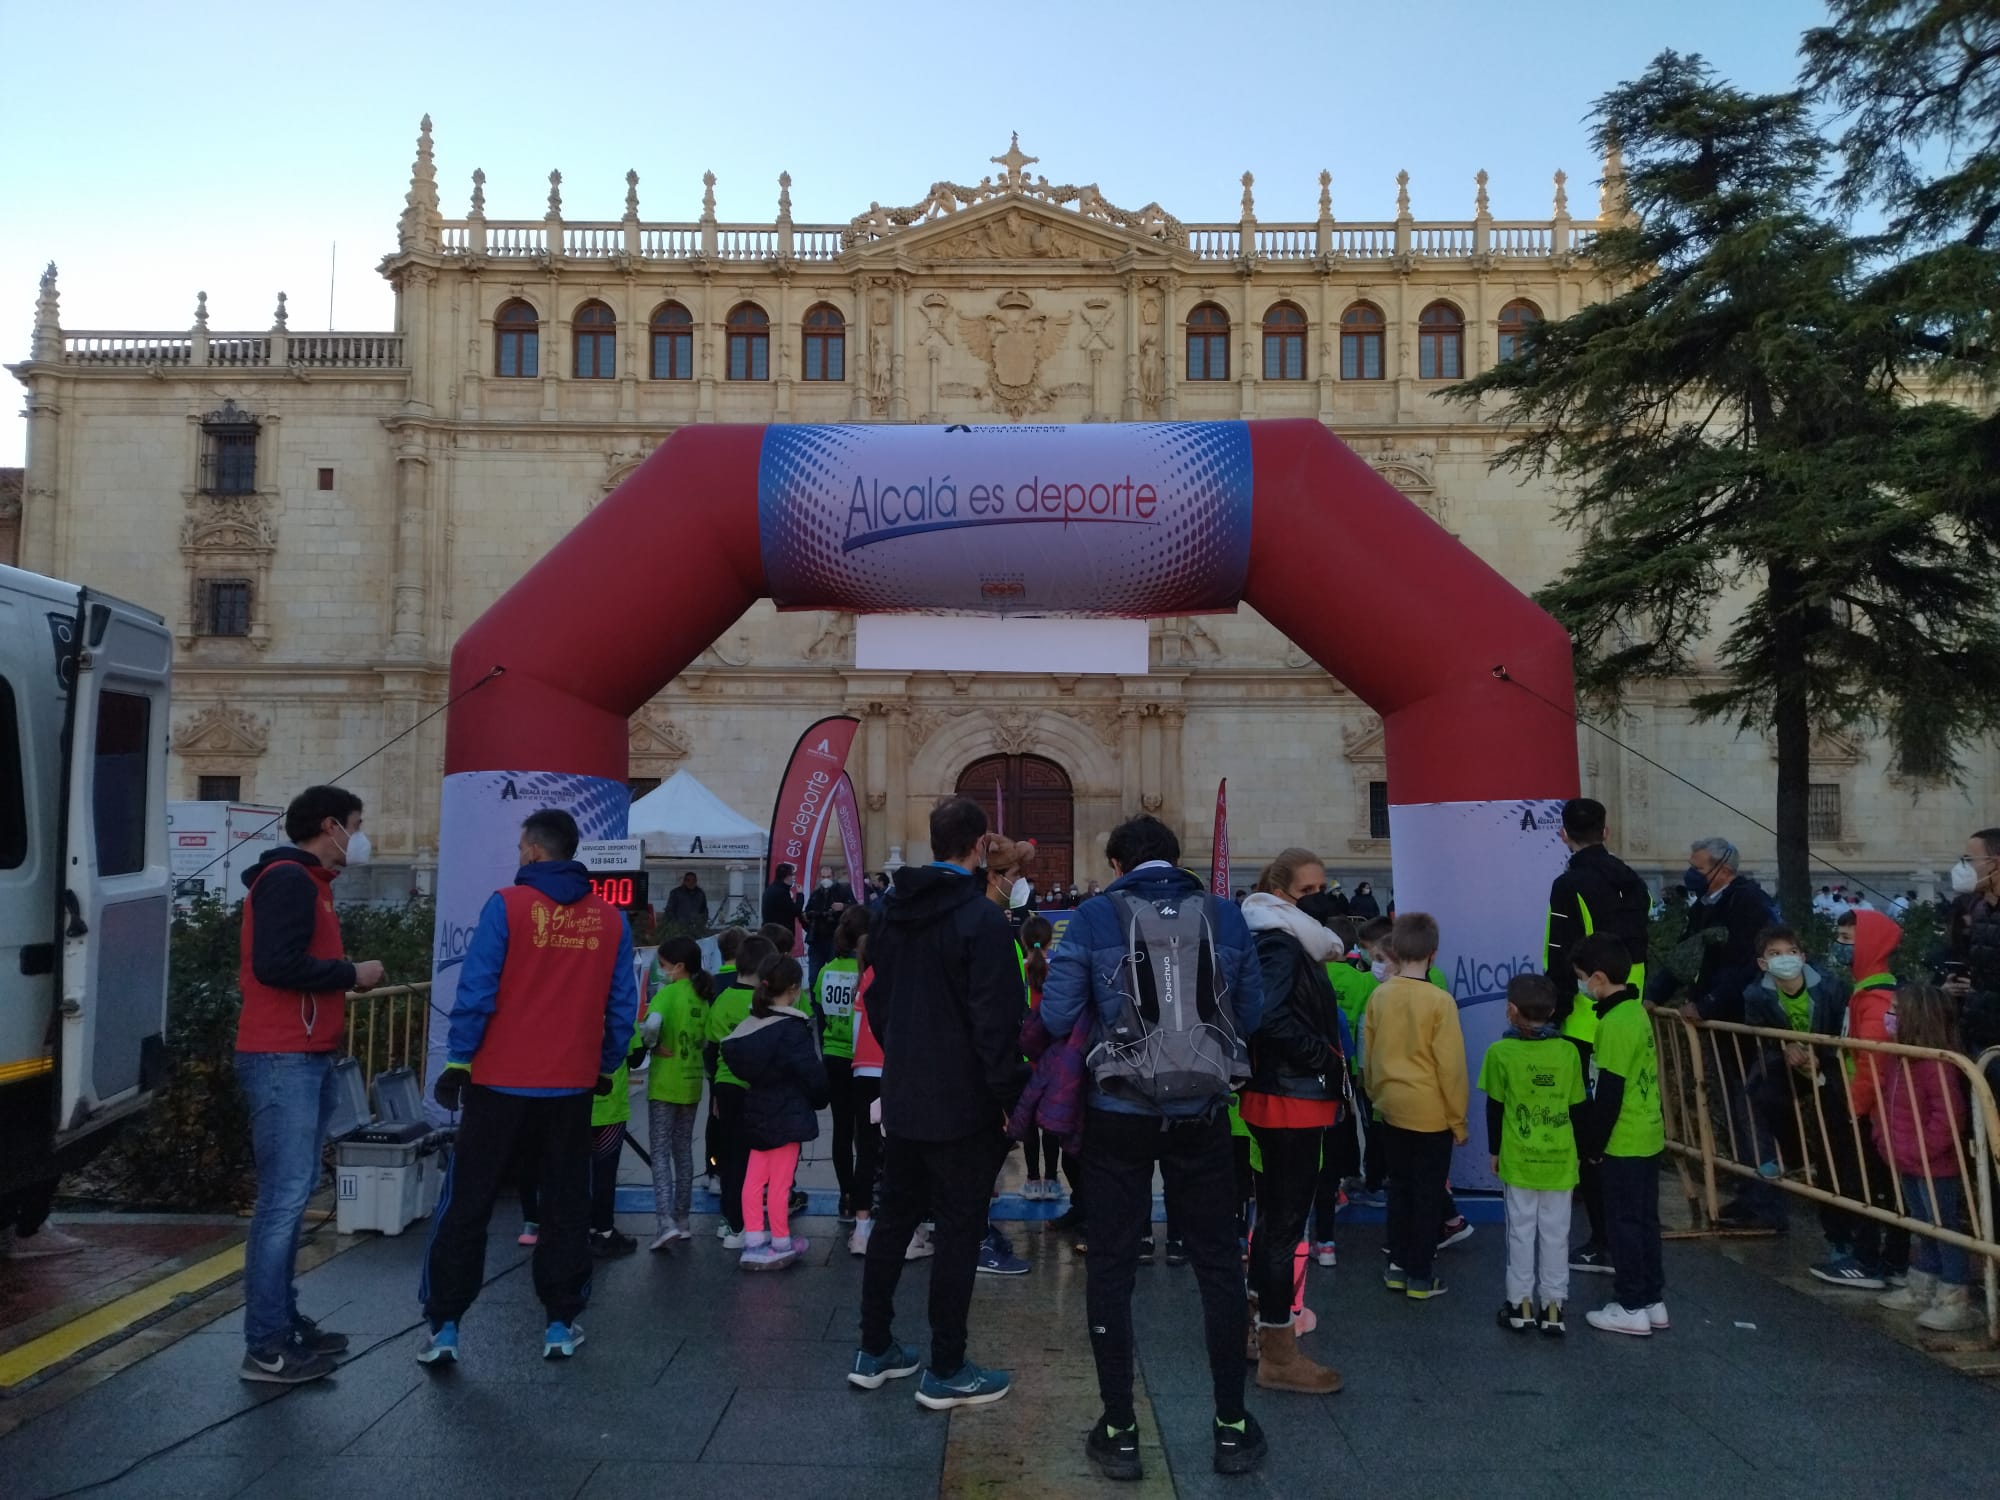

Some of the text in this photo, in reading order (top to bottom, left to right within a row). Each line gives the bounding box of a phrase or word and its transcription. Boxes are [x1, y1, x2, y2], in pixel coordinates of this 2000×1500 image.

[846, 475, 1157, 539] Alcalá es deporte
[787, 771, 829, 837] deporte
[786, 839, 802, 858] es
[825, 985, 851, 1005] 305
[1163, 956, 1173, 1003] Quechua
